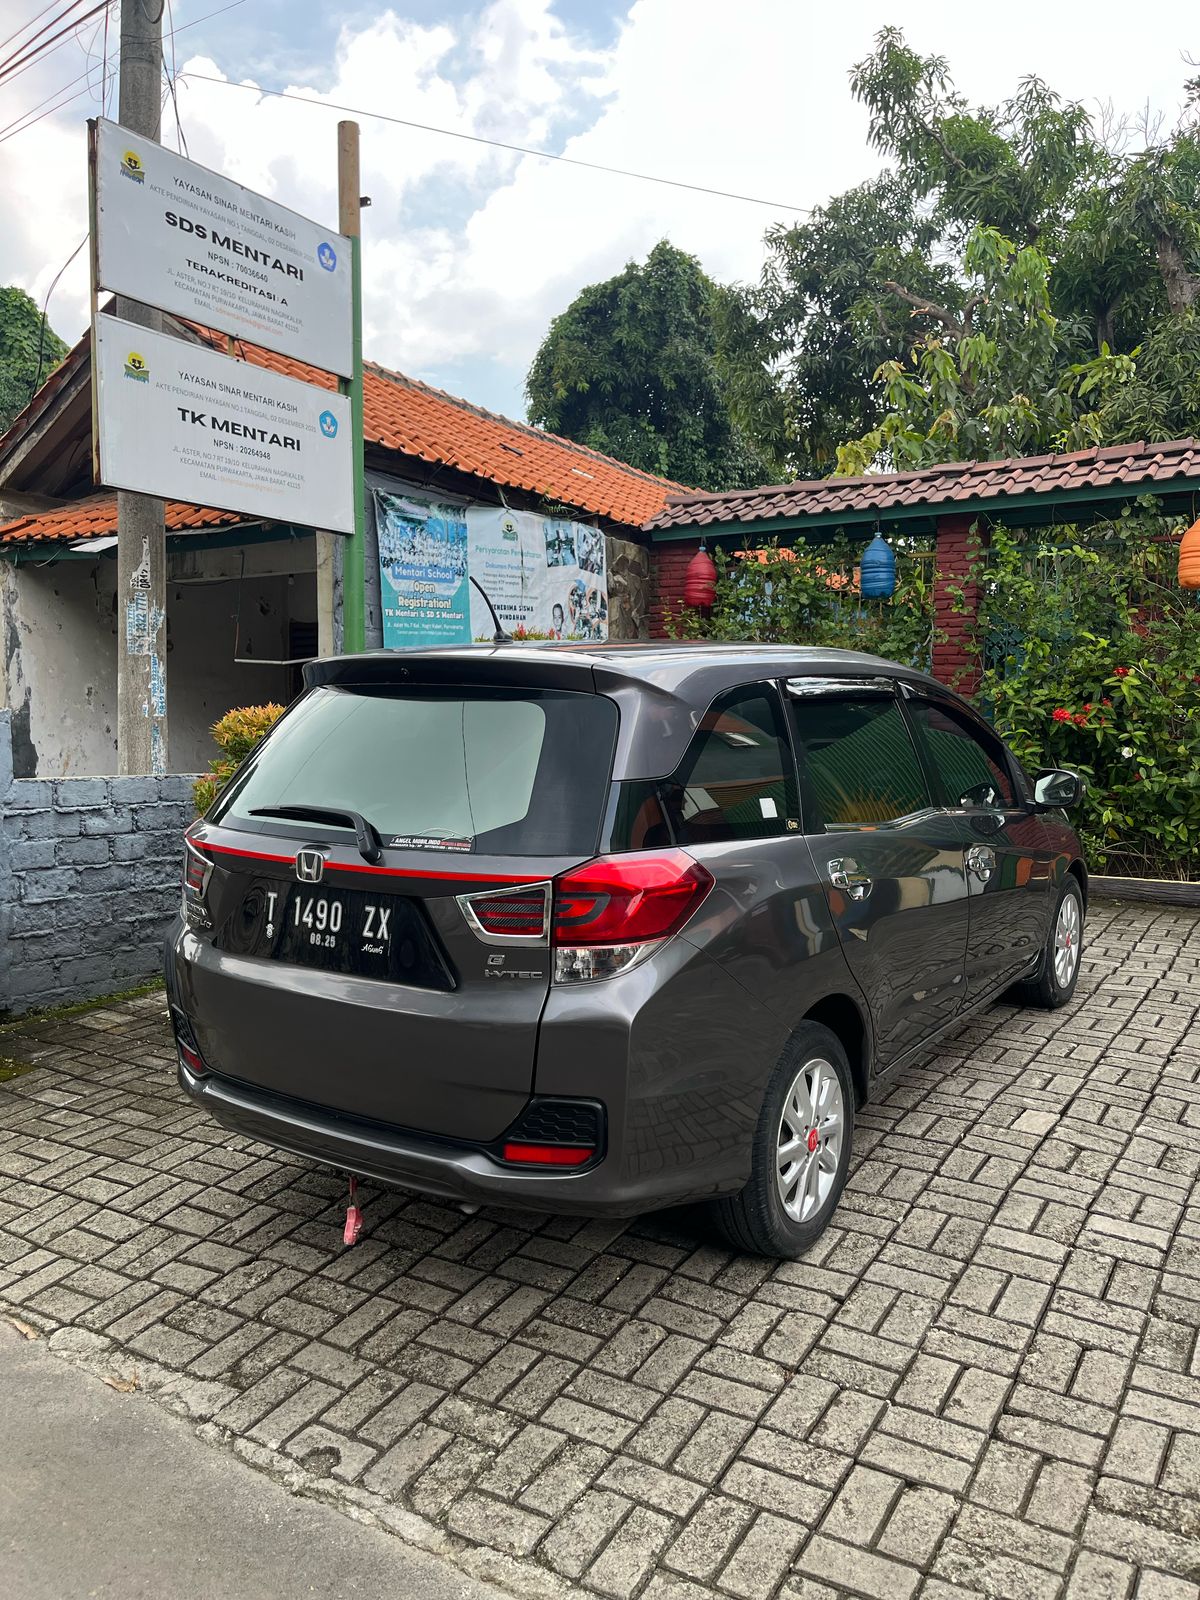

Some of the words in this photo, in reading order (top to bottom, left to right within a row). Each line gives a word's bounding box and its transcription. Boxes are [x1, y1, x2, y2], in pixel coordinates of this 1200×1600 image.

[150, 184, 167, 197] AKTE
[166, 191, 199, 211] PENDIRIAN
[199, 206, 226, 223] YAYASAN
[173, 177, 212, 201] YAYASAN
[214, 196, 238, 214] SINAR
[240, 208, 273, 229] MENTARI
[274, 222, 296, 240] KASIH
[165, 211, 207, 240] SDS
[212, 230, 304, 282] MENTARI
[208, 251, 230, 267] NPSN
[174, 281, 211, 301] KECAMATAN
[186, 258, 276, 301] TERAKREDITASI
[280, 298, 289, 306] A
[155, 382, 171, 393] AKTE
[172, 386, 204, 401] PENDIRIAN
[205, 396, 231, 409] YAYASAN
[178, 370, 217, 390] YAYASAN
[218, 383, 242, 397] SINAR
[243, 390, 275, 408] MENTARI
[276, 401, 298, 414] KASIH
[177, 407, 207, 428] TK
[211, 416, 301, 451] MENTARI
[213, 439, 234, 451] NPSN
[240, 445, 271, 460] 20264948
[180, 457, 215, 470] KECAMATAN
[475, 545, 510, 557] Persyaratan
[394, 566, 426, 578] Mentari
[427, 567, 452, 580] School
[413, 582, 436, 594] Open
[398, 596, 451, 609] Registration!
[518, 604, 534, 612] SISWA
[385, 608, 393, 617] TK
[395, 609, 418, 618] Mentari
[426, 610, 435, 618] SD
[441, 610, 464, 619] Mentari
[267, 891, 278, 922] T
[295, 895, 342, 932] 1490
[362, 905, 391, 940] ZX
[310, 932, 336, 948] 08.25
